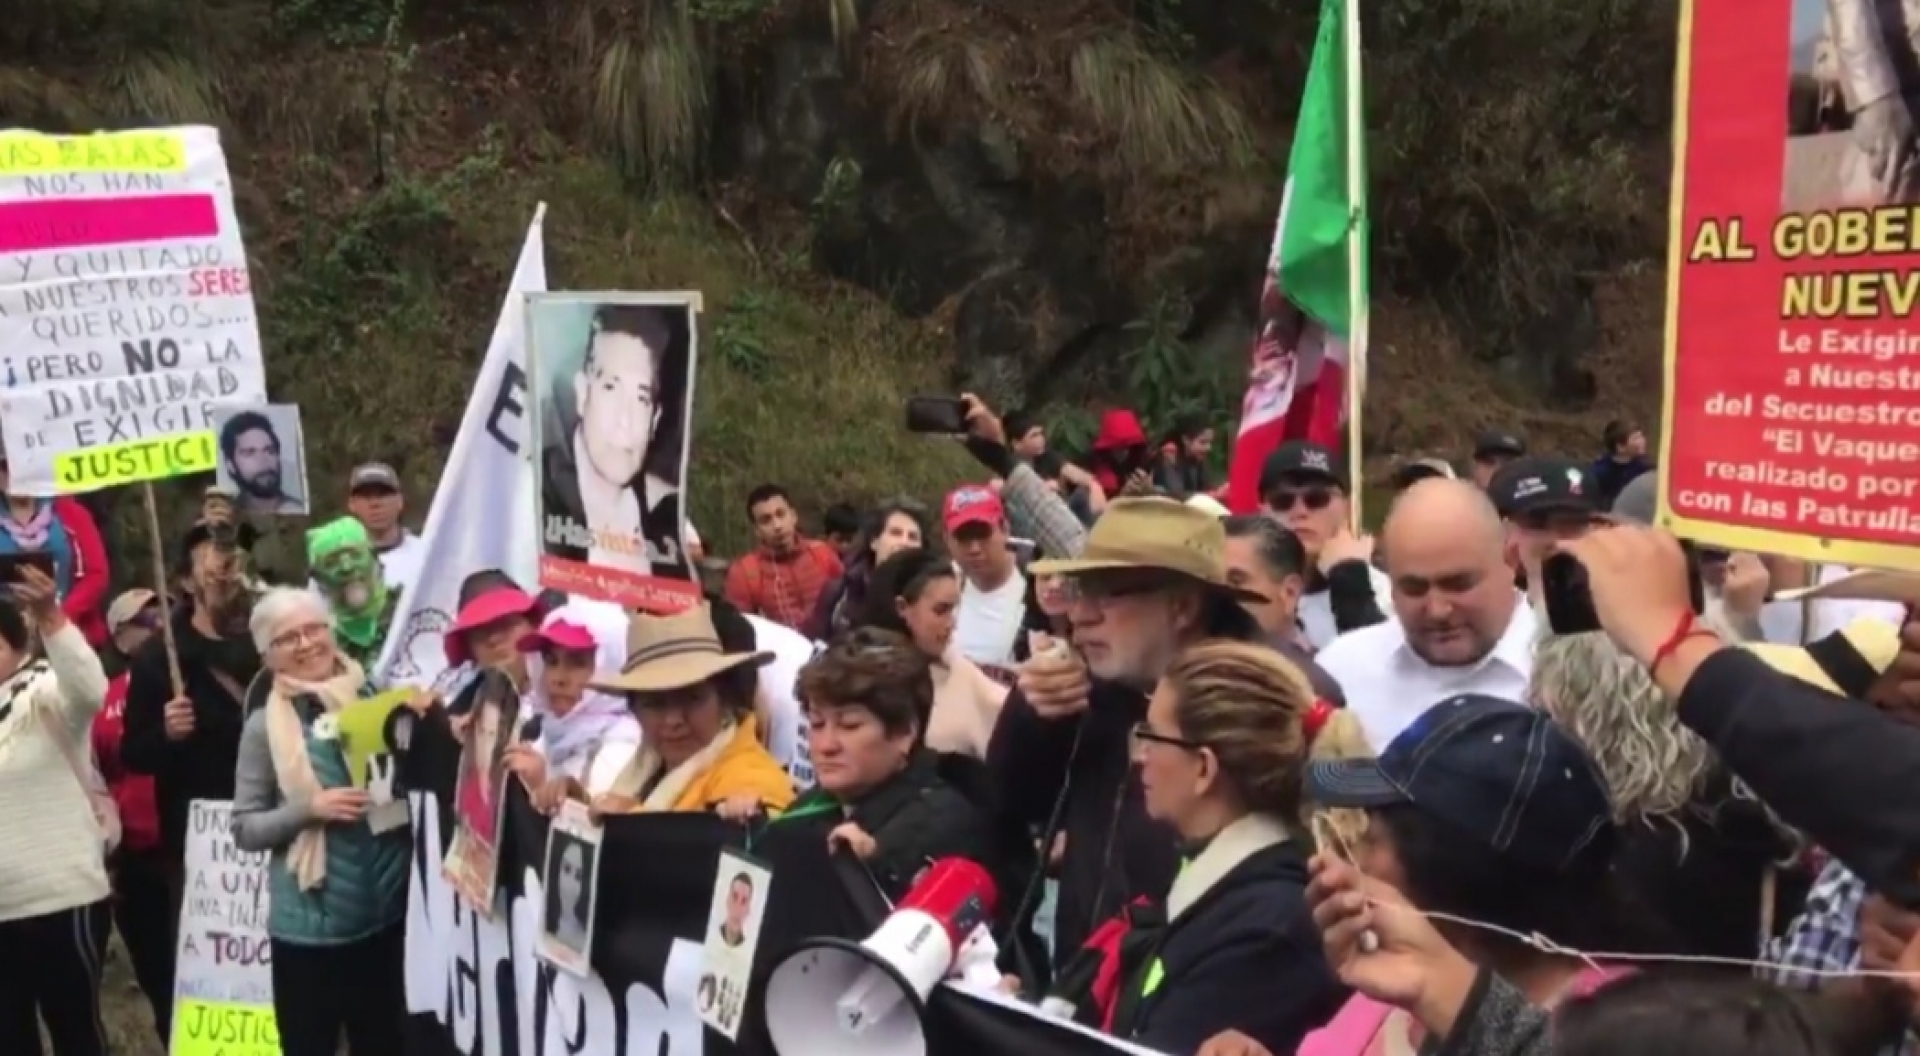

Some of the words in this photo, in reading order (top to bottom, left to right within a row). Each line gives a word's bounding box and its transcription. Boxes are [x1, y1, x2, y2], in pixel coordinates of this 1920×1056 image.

[0, 141, 42, 168] AS
[25, 174, 85, 196] NOS
[102, 172, 163, 193] HAN
[1690, 219, 1755, 261] AL
[1774, 207, 1920, 258] GOBE
[14, 254, 32, 282] Y
[54, 244, 222, 279] QUITADO
[23, 274, 181, 313] NUESTROS
[1782, 270, 1920, 317] NUEV
[121, 337, 179, 376] NO
[206, 338, 241, 363] LA
[1779, 329, 1812, 354] Le
[44, 366, 238, 420] DIGNIDAD
[1785, 368, 1800, 387] a
[1704, 391, 1752, 417] del
[1762, 394, 1920, 427] Secuestro
[65, 437, 213, 483] JUSTICI
[1812, 430, 1919, 465] Vaque
[1705, 460, 1848, 492] realizado
[1858, 475, 1918, 500] por
[1678, 489, 1731, 512] con
[1741, 490, 1787, 519] las
[194, 803, 232, 834] UN
[195, 869, 208, 891] A
[221, 869, 272, 894] UN
[183, 933, 199, 957] A
